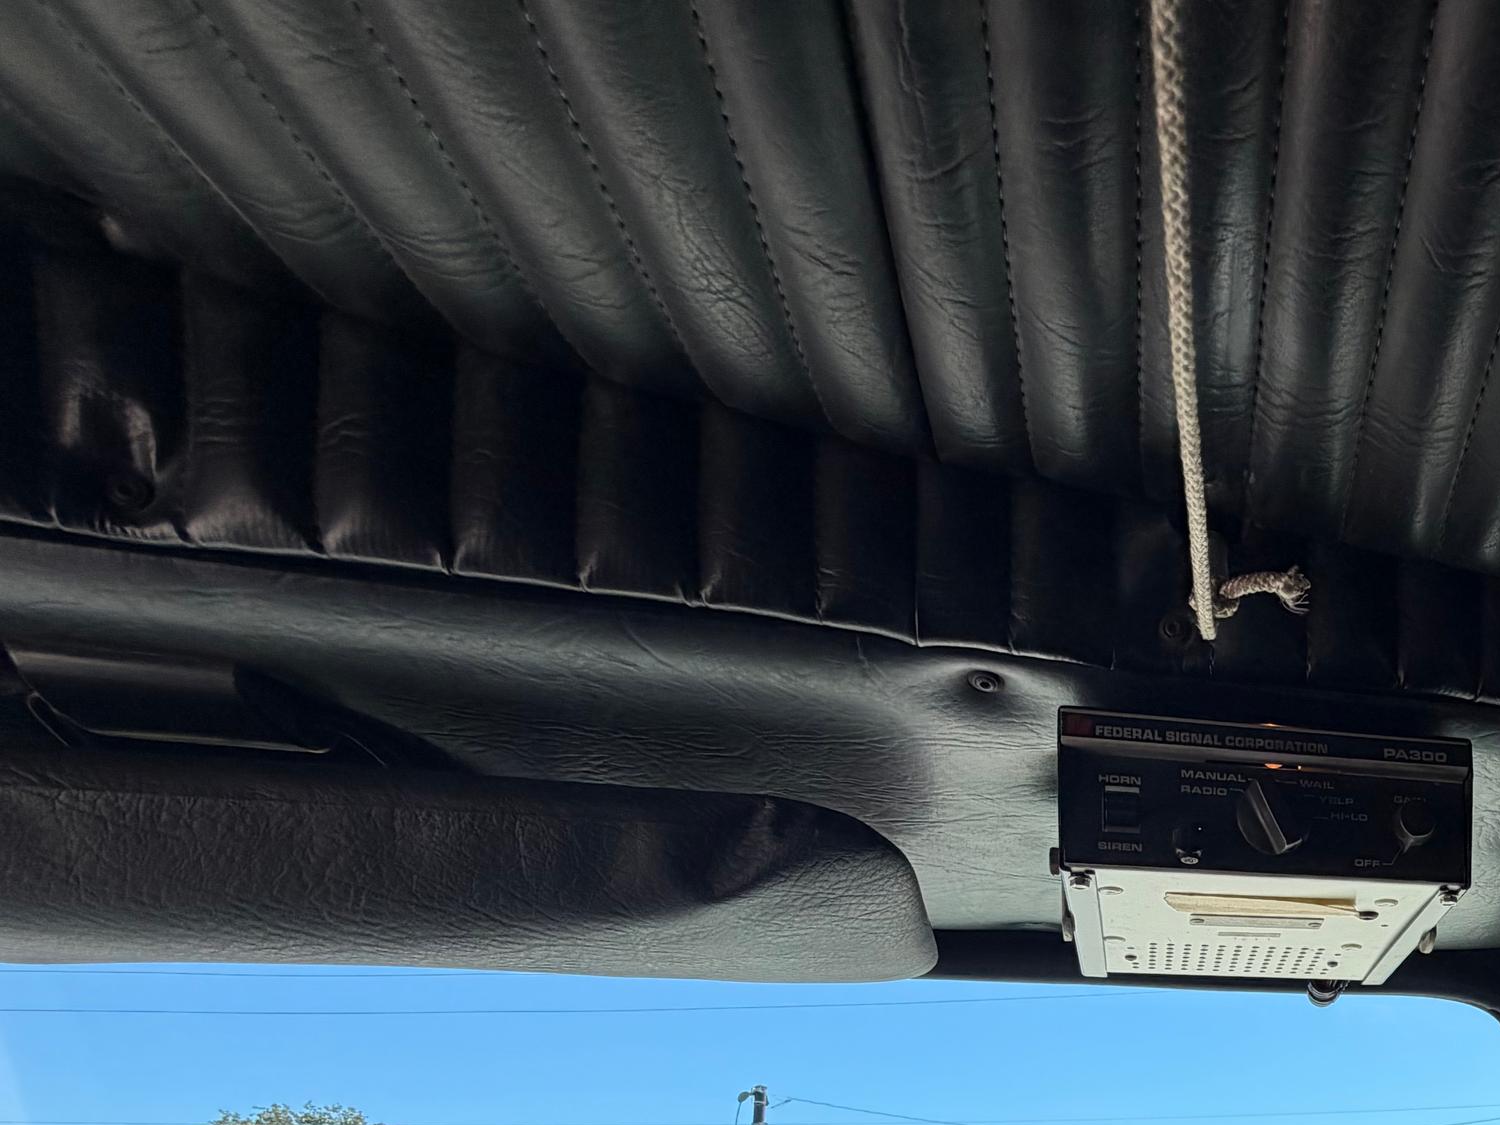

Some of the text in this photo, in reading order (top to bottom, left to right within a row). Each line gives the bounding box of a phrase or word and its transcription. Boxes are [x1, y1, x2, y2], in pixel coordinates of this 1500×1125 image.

[1095, 724, 1329, 754] FEDERAL SIGNAL CORPORATION
[1383, 748, 1448, 763] PA300
[1098, 774, 1142, 786] HORN
[1180, 769, 1246, 783] MANUAL
[1300, 779, 1336, 790] WAIL
[1180, 785, 1228, 797] RADIO
[1098, 841, 1143, 853] SIREN
[1354, 858, 1383, 869] OFF
